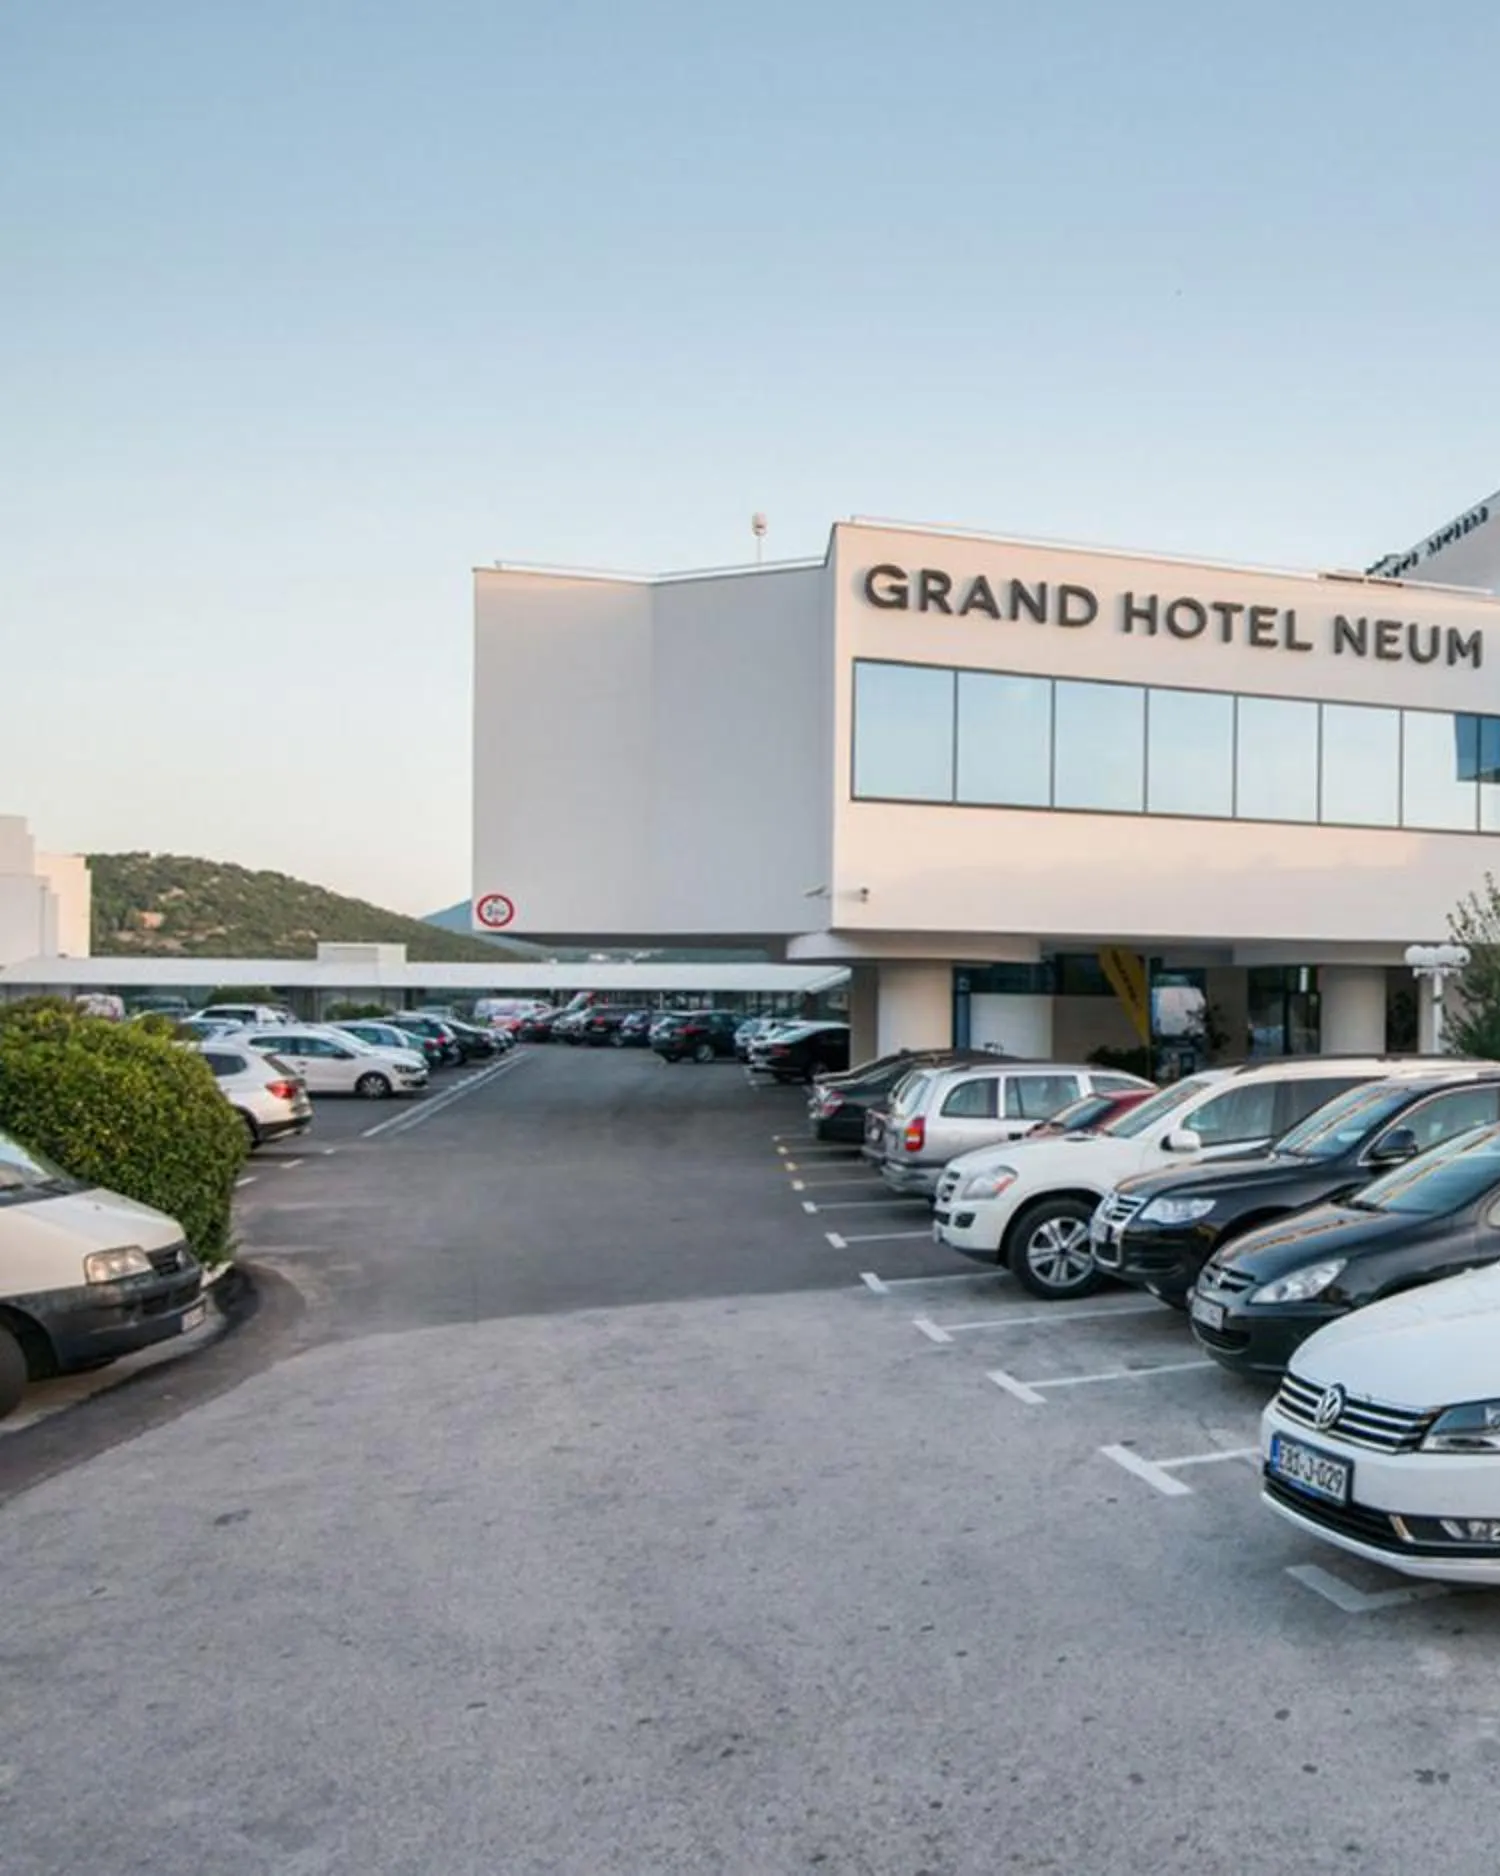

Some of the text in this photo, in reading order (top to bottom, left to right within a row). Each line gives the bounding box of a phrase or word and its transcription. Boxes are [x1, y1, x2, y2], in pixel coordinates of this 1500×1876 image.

[863, 563, 1483, 669] GRAND HOTEL NEUM
